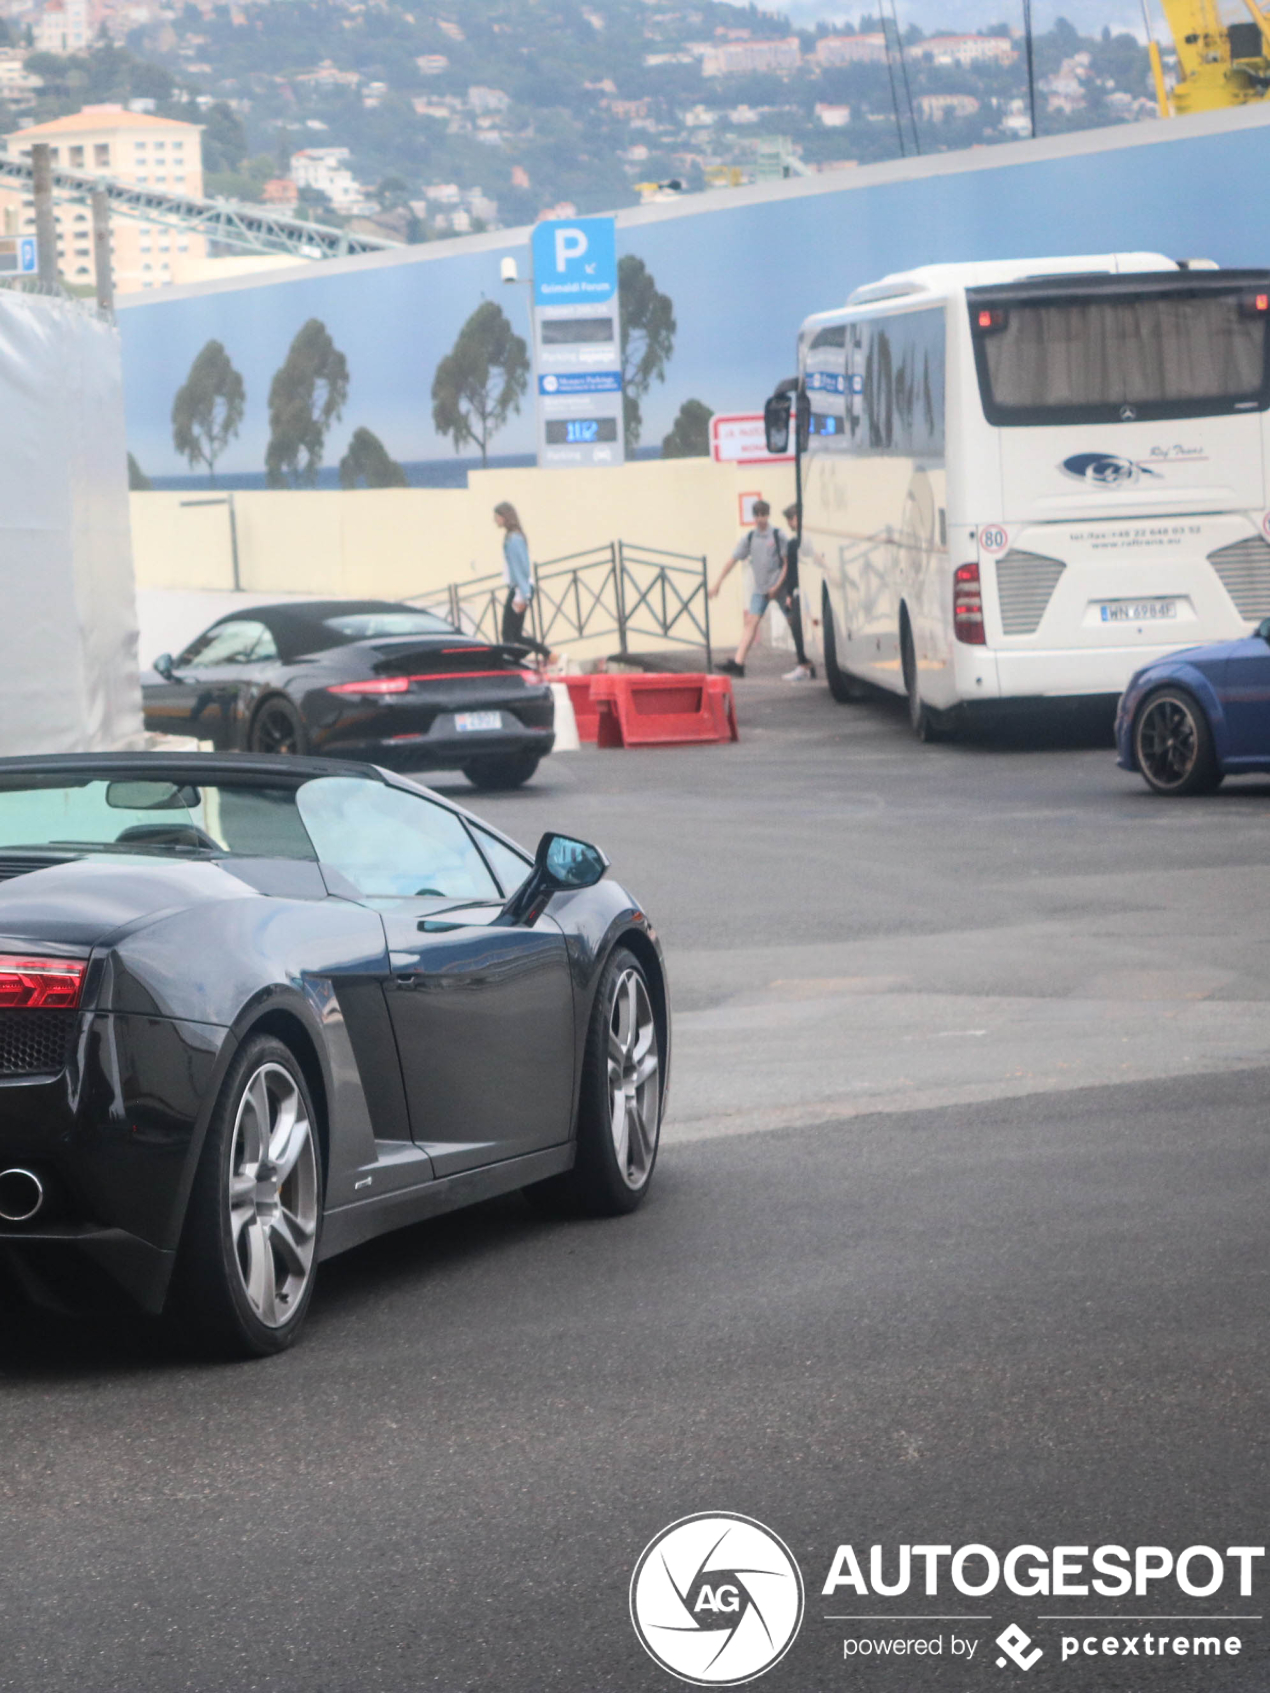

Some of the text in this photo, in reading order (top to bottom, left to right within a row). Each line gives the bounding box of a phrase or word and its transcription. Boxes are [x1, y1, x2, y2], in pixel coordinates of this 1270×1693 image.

[555, 228, 588, 272] P
[984, 531, 1003, 547] 80
[1109, 605, 1129, 620] WN
